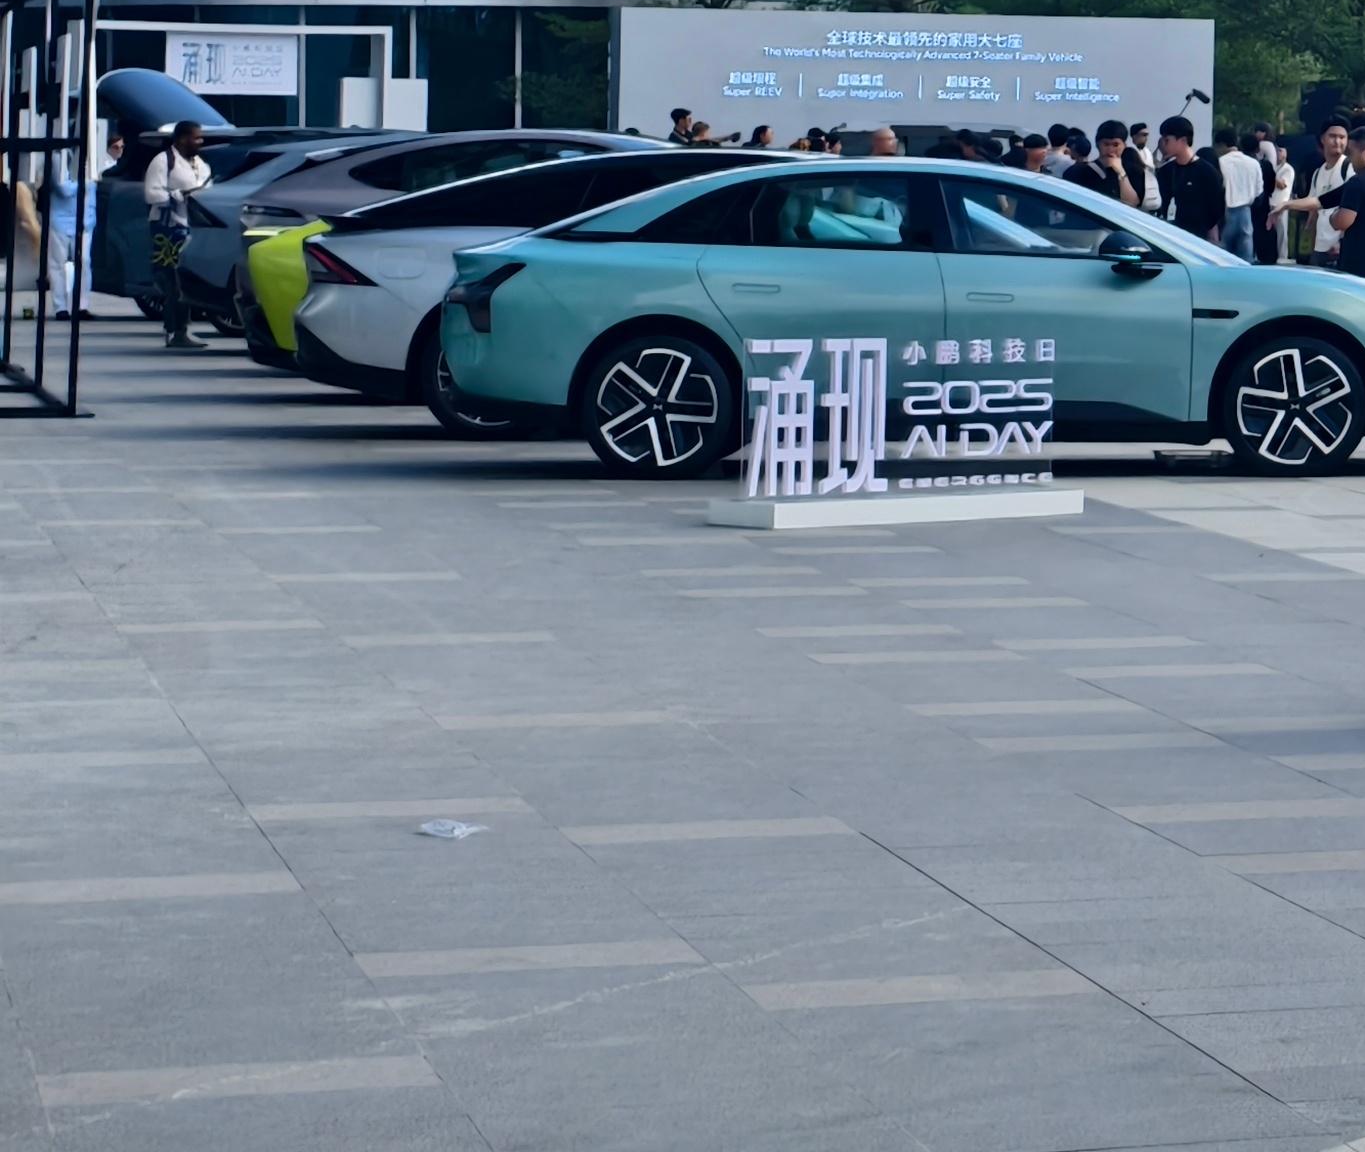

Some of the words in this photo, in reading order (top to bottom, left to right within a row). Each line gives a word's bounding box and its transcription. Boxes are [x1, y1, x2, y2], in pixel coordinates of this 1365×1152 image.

[826, 30, 1023, 48] 全球技术最领先的家用大七座
[763, 47, 782, 58] The
[784, 48, 820, 58] World's
[822, 48, 847, 58] Most
[849, 48, 921, 61] Technologically
[923, 50, 971, 60] Advanced
[973, 51, 1013, 61] 7-Seater
[1015, 52, 1046, 64] Family
[1048, 53, 1083, 63] Vehicle
[722, 86, 751, 97] Super
[817, 88, 846, 99] Super
[850, 89, 904, 100] Integration
[937, 90, 965, 101] Super
[969, 91, 1001, 102] Safety
[1034, 91, 1062, 102] Super
[1065, 92, 1120, 104] Intelligence
[903, 337, 1056, 366] 小鹏科技日
[902, 377, 1054, 416] 2025
[747, 337, 888, 497] 涌现
[901, 423, 947, 459] AI
[960, 420, 1055, 457] DAY
